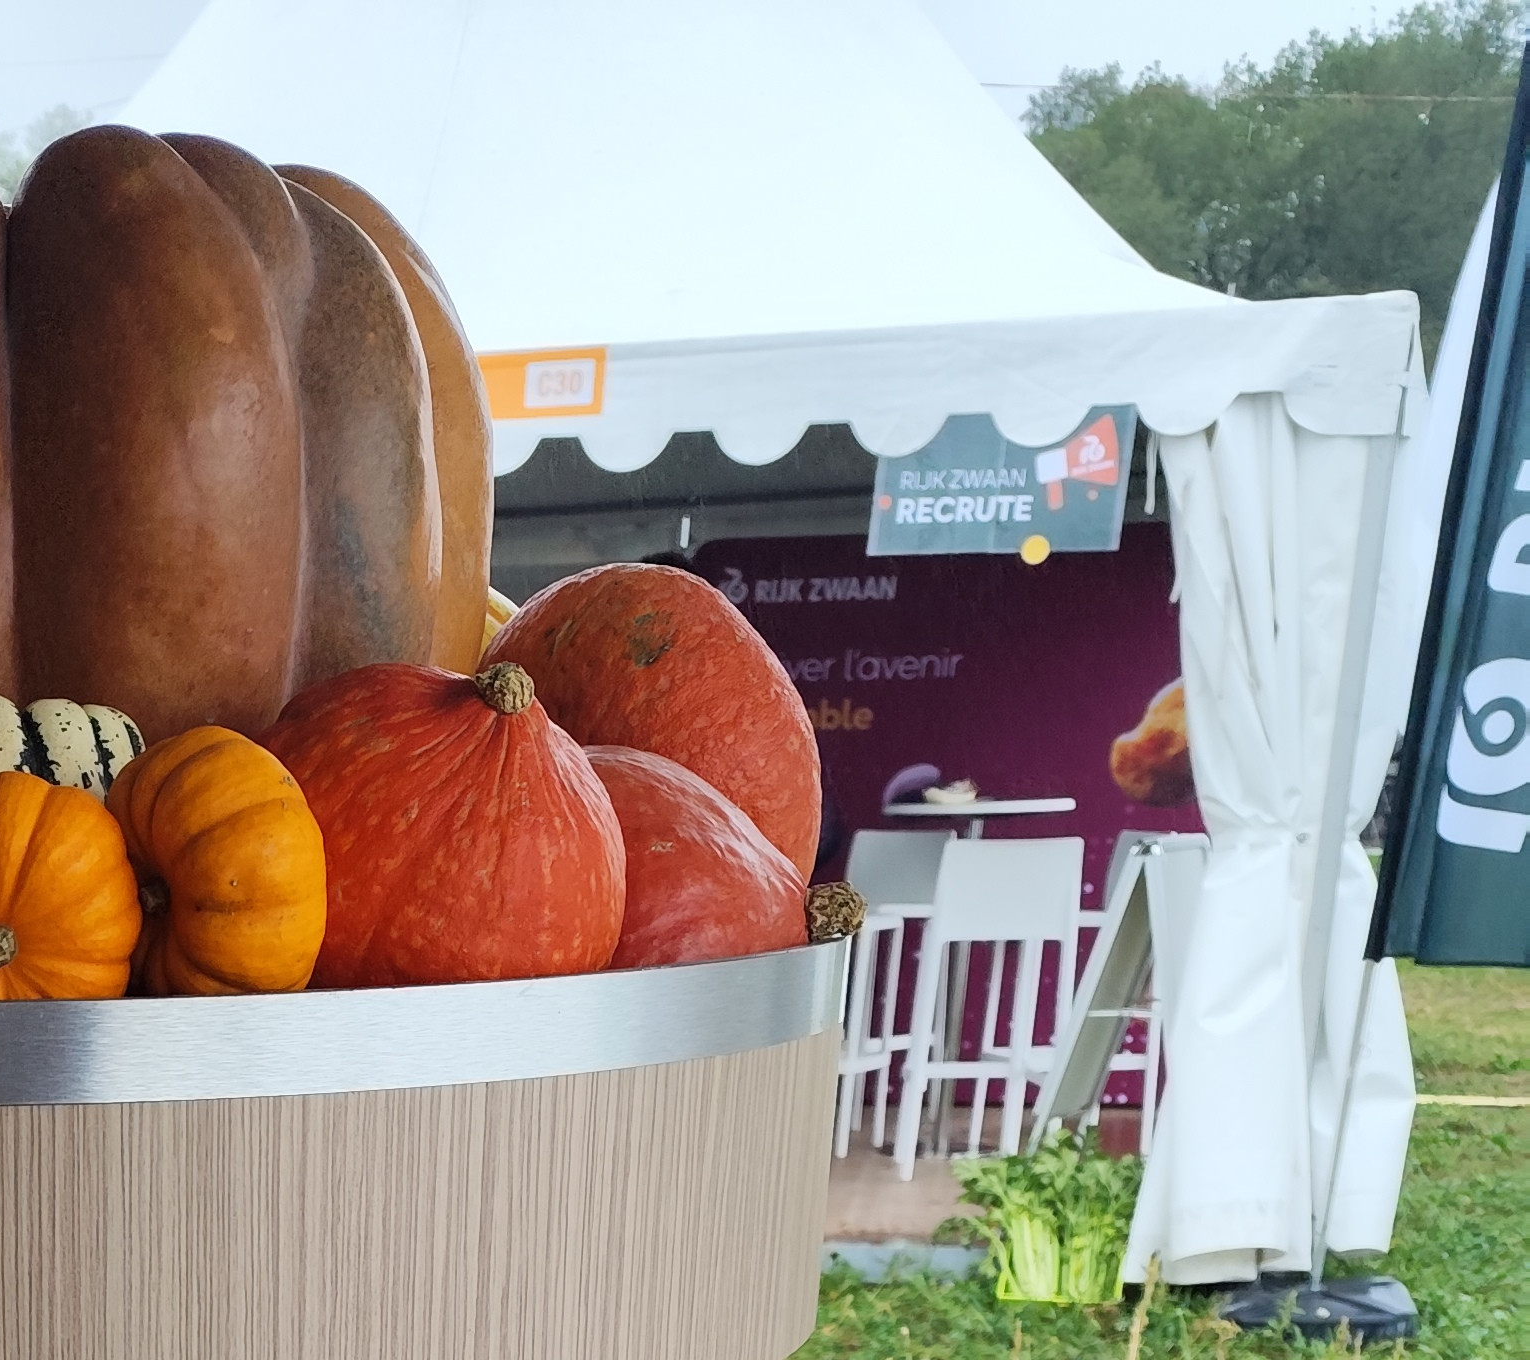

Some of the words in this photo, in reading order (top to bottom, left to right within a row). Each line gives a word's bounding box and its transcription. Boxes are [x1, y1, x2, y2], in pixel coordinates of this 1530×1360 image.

[536, 369, 584, 398] C30
[899, 469, 947, 491] RIJK
[948, 468, 1027, 490] ZWAAN
[895, 494, 1034, 524] RECRUTE
[755, 577, 805, 603] RIJK
[809, 575, 898, 602] ZWAAN
[843, 649, 965, 682] l'avenir
